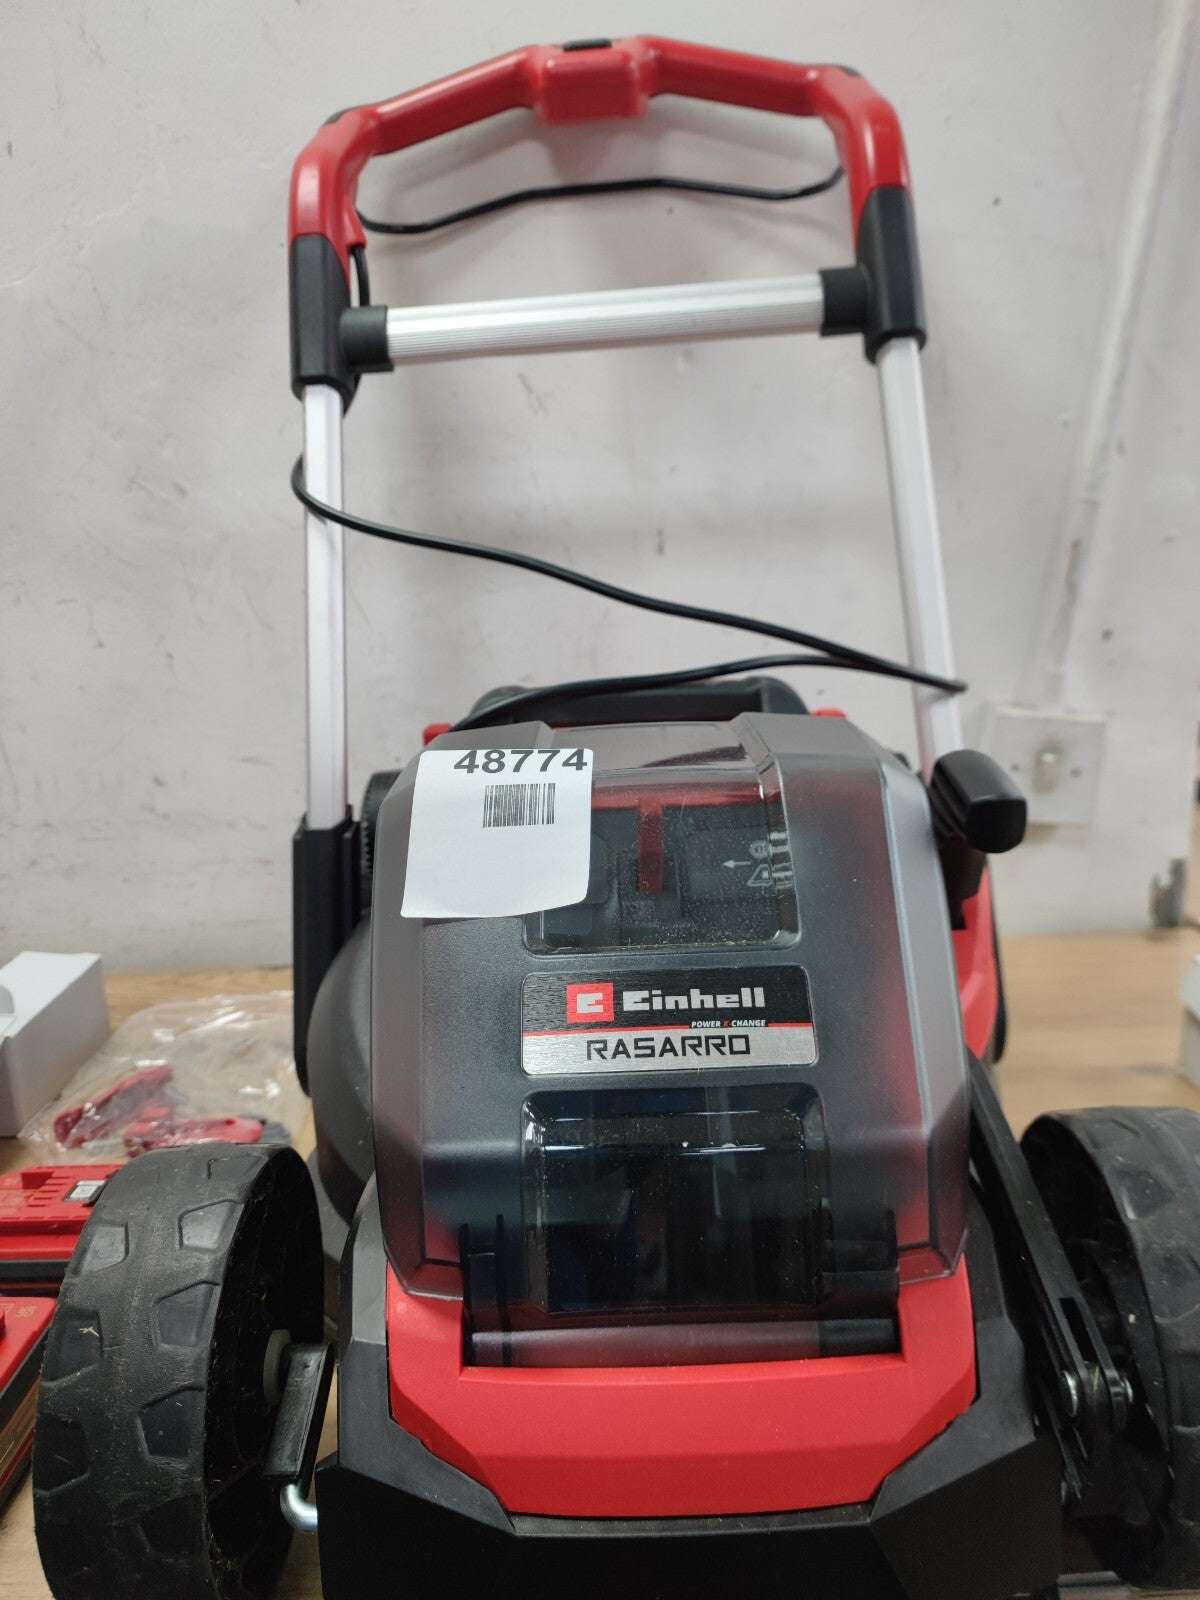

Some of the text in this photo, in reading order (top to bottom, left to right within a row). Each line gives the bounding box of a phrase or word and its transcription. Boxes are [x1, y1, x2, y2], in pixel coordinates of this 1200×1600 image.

[454, 749, 587, 773] 48774
[623, 987, 765, 1011] Einhell
[691, 1020, 721, 1028] POWER
[587, 1034, 750, 1060] RASARRO
